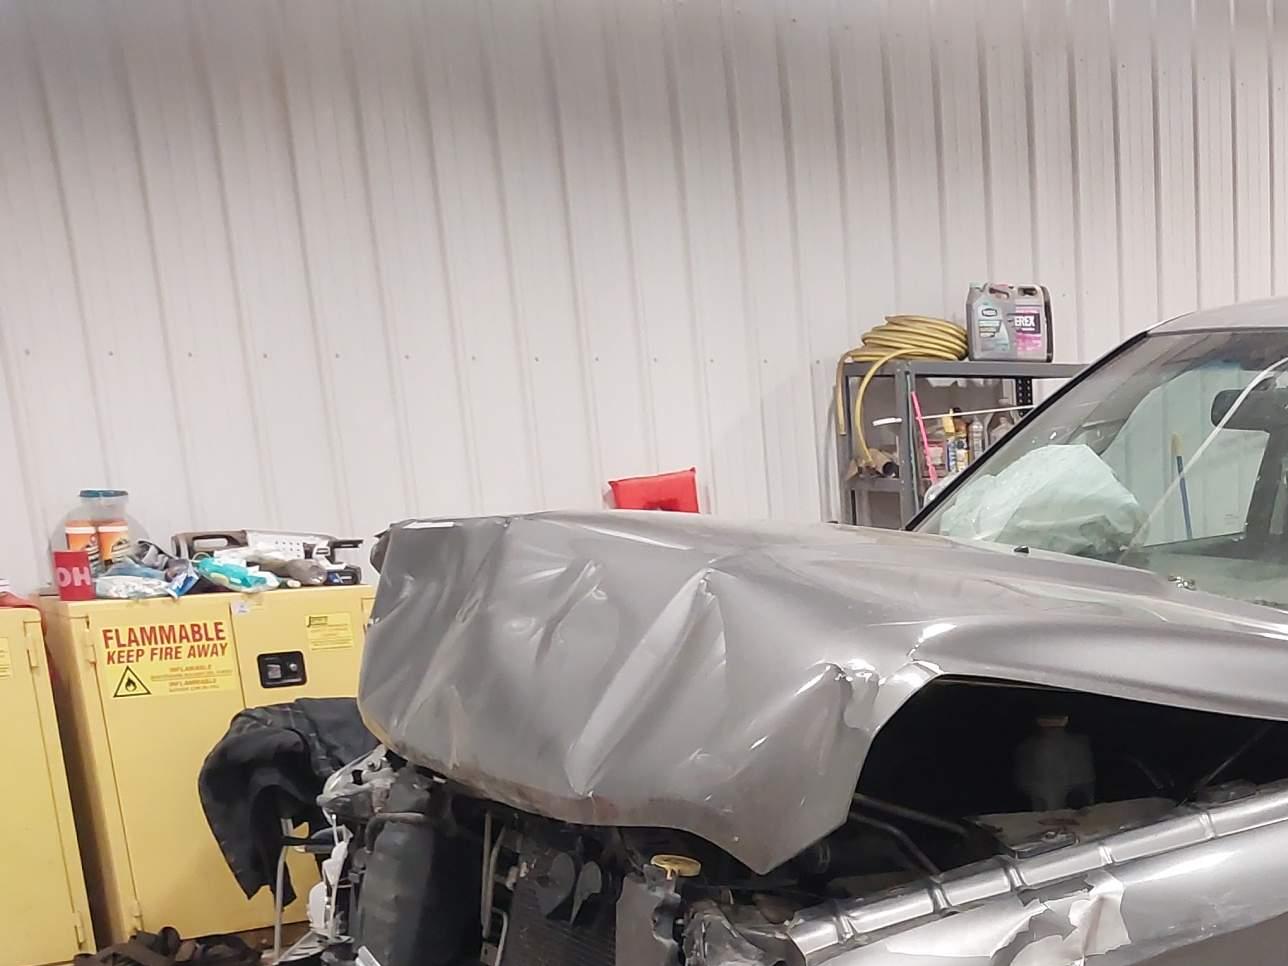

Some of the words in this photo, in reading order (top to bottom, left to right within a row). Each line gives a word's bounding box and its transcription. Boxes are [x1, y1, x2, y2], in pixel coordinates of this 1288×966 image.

[102, 621, 226, 649] FLAMMABLE
[107, 649, 145, 665] KEEP
[150, 646, 182, 662] FIRE
[187, 643, 228, 659] AWAY
